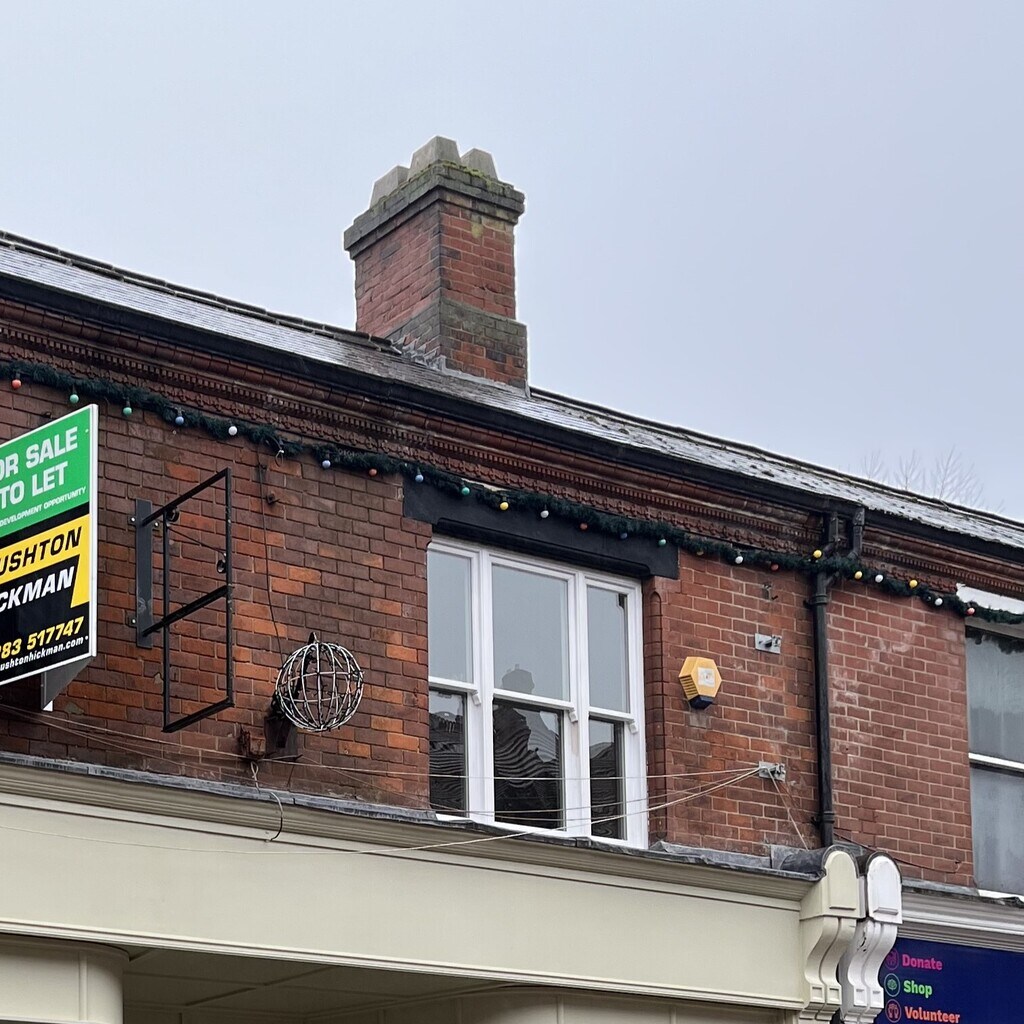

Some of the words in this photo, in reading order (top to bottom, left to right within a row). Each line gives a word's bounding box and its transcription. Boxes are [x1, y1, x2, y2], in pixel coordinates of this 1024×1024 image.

[26, 426, 78, 469] SALE
[32, 462, 68, 497] LET
[43, 486, 87, 510] OPPORTUNITY
[26, 616, 84, 650] 517747
[902, 954, 943, 971] Donate
[903, 979, 933, 998] Shop
[904, 1006, 961, 1024] Volunteer
